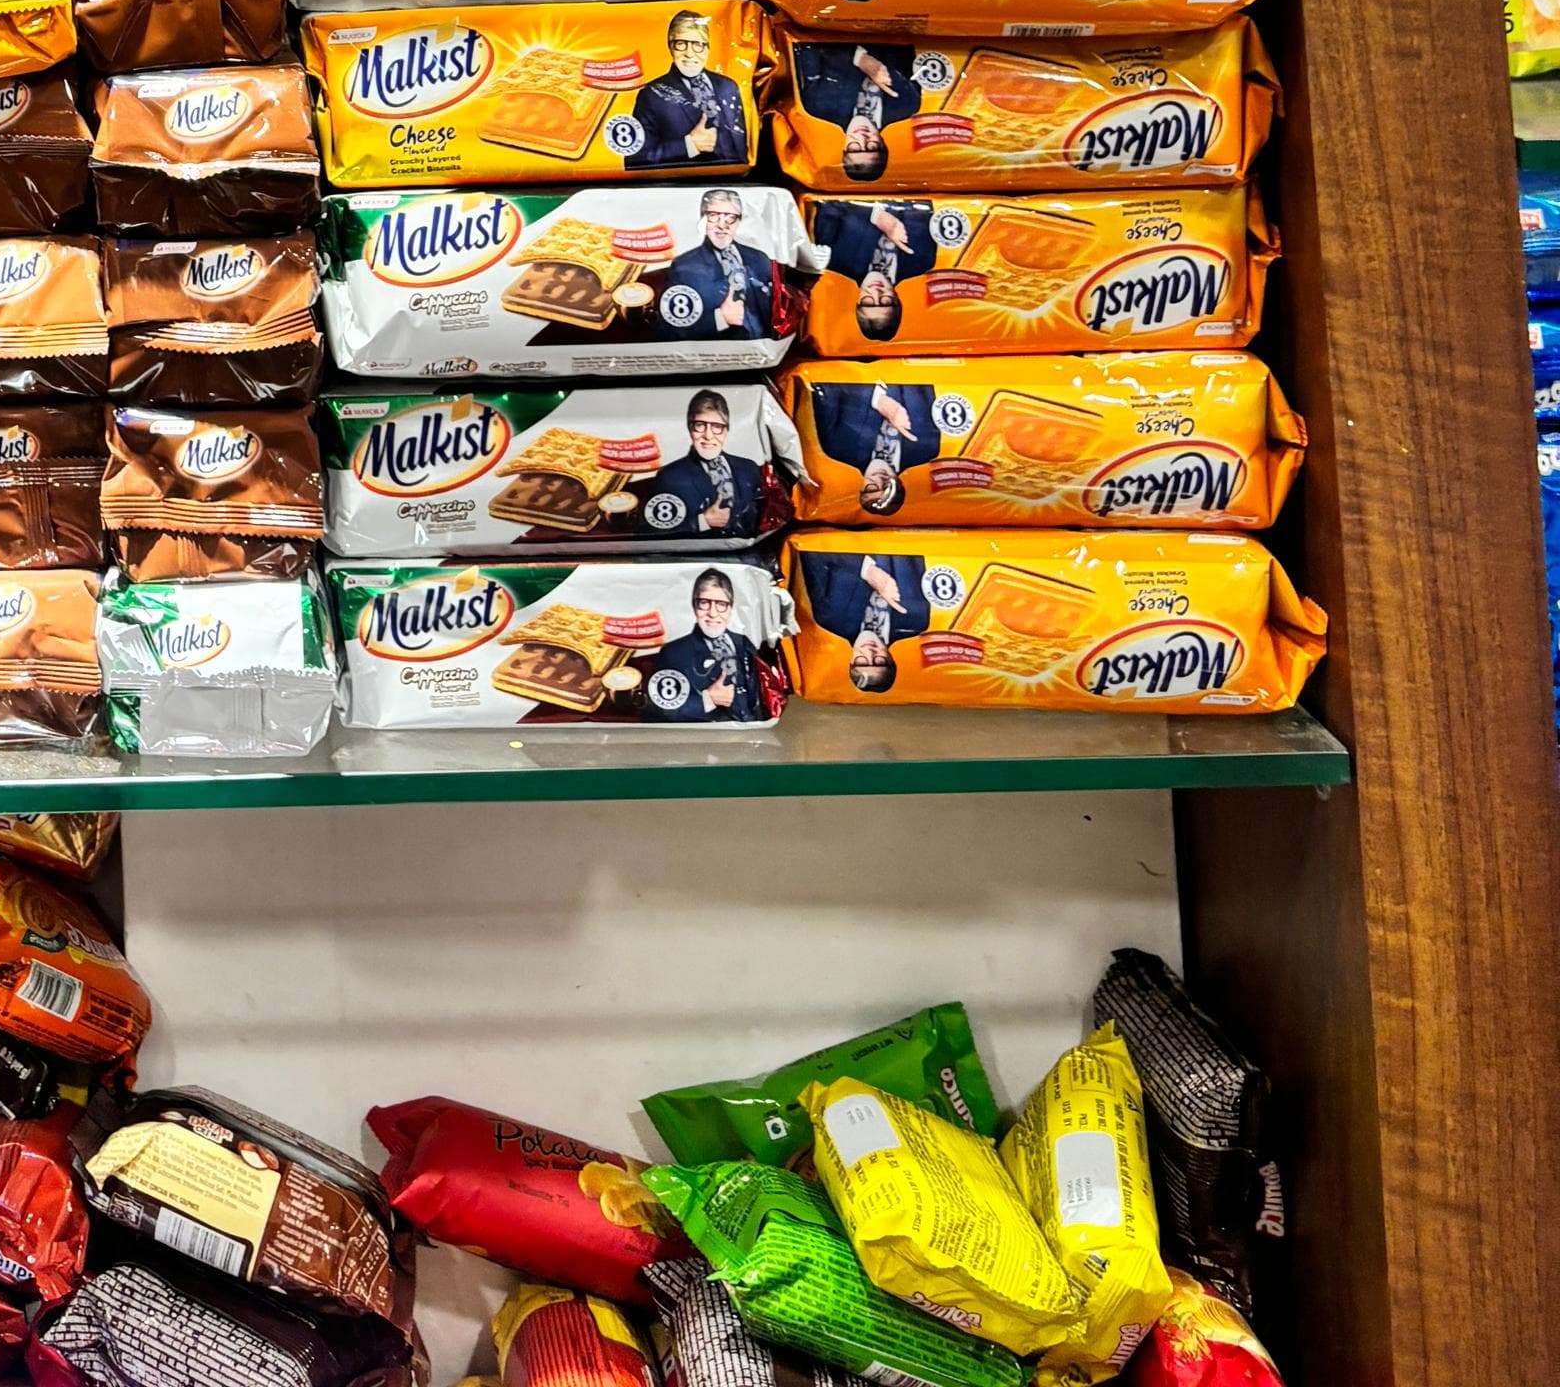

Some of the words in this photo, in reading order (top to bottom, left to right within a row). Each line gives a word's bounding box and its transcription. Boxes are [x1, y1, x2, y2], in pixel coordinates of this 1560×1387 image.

[348, 30, 483, 108] Malkist
[170, 87, 242, 133] Malkist
[389, 123, 457, 147] Cheese
[371, 198, 509, 276] Malkist
[360, 406, 498, 486] Malkist
[396, 498, 476, 520] Cappuccino
[1091, 451, 1243, 517] Malkist
[364, 584, 501, 651] Malkist
[1129, 595, 1190, 616] Cheese
